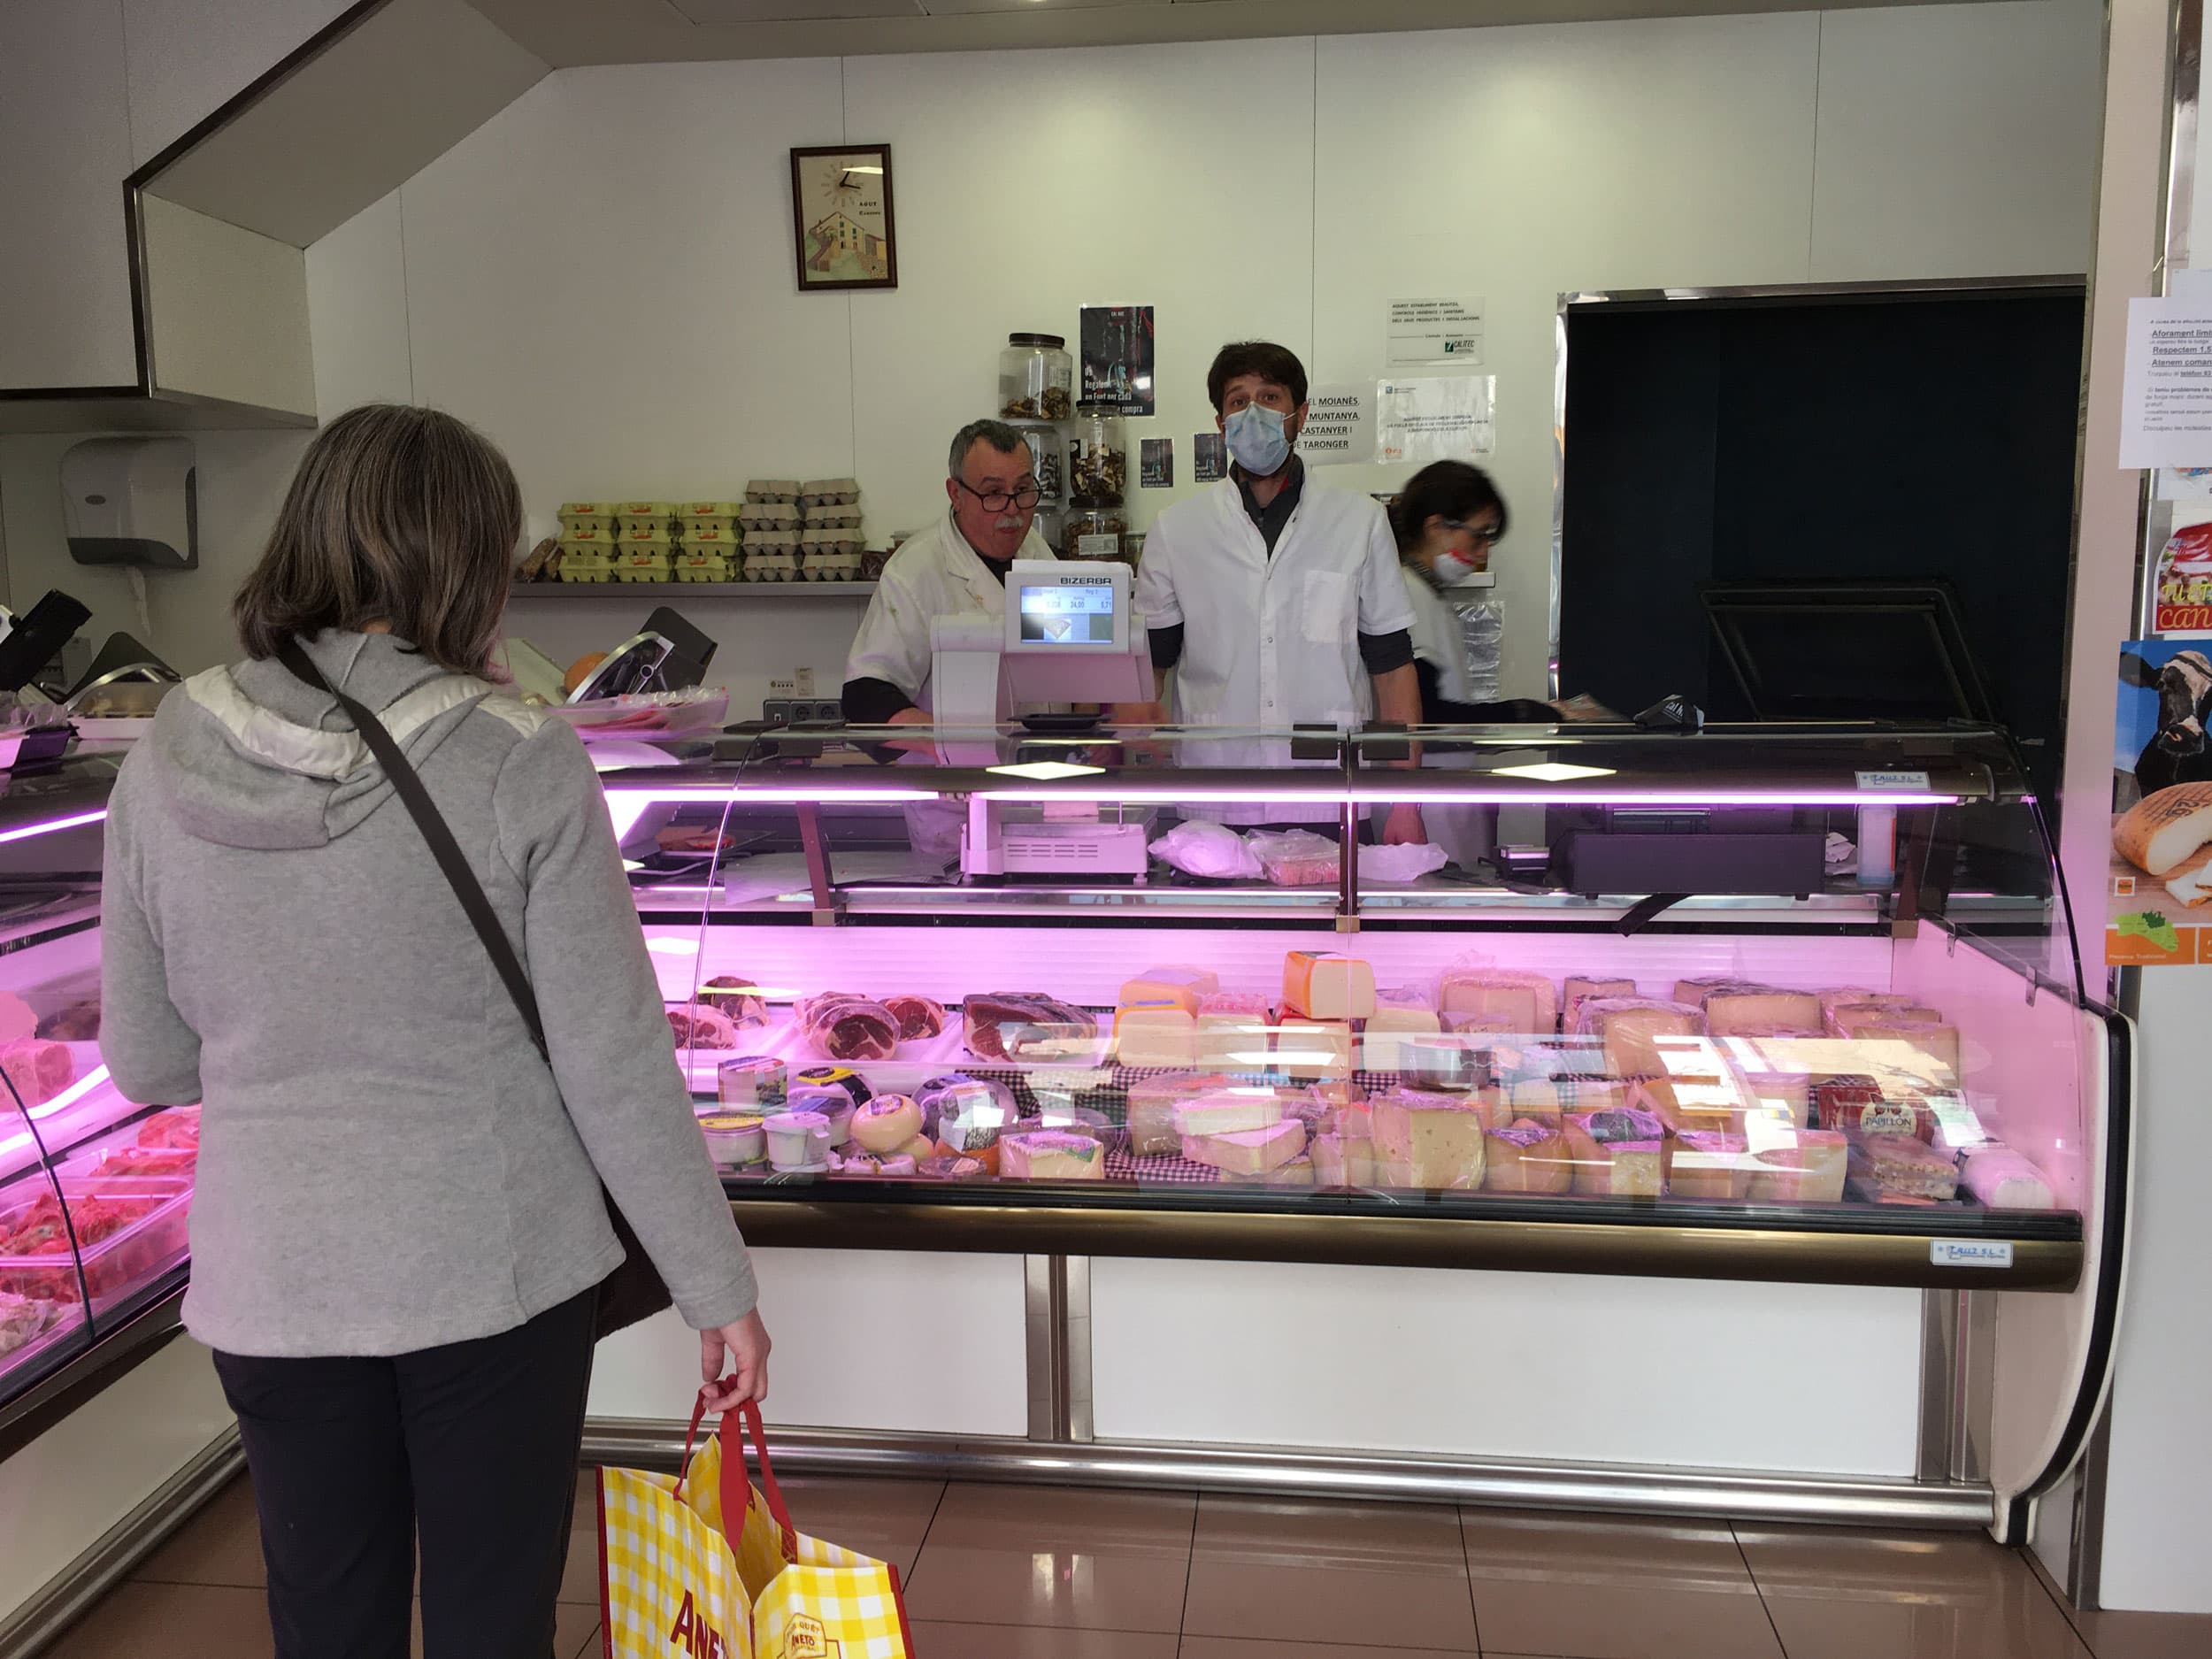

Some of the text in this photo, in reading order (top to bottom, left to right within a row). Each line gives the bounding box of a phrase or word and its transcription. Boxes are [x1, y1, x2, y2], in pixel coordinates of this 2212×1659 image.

[2152, 329, 2194, 338] Aforament
[2152, 346, 2197, 355] Respectem
[1318, 396, 1360, 405] MOIANÈS,
[1121, 405, 1143, 415] compra
[1310, 411, 1361, 420] MUNTANYA,
[1865, 1117, 1912, 1126] PAPILLON
